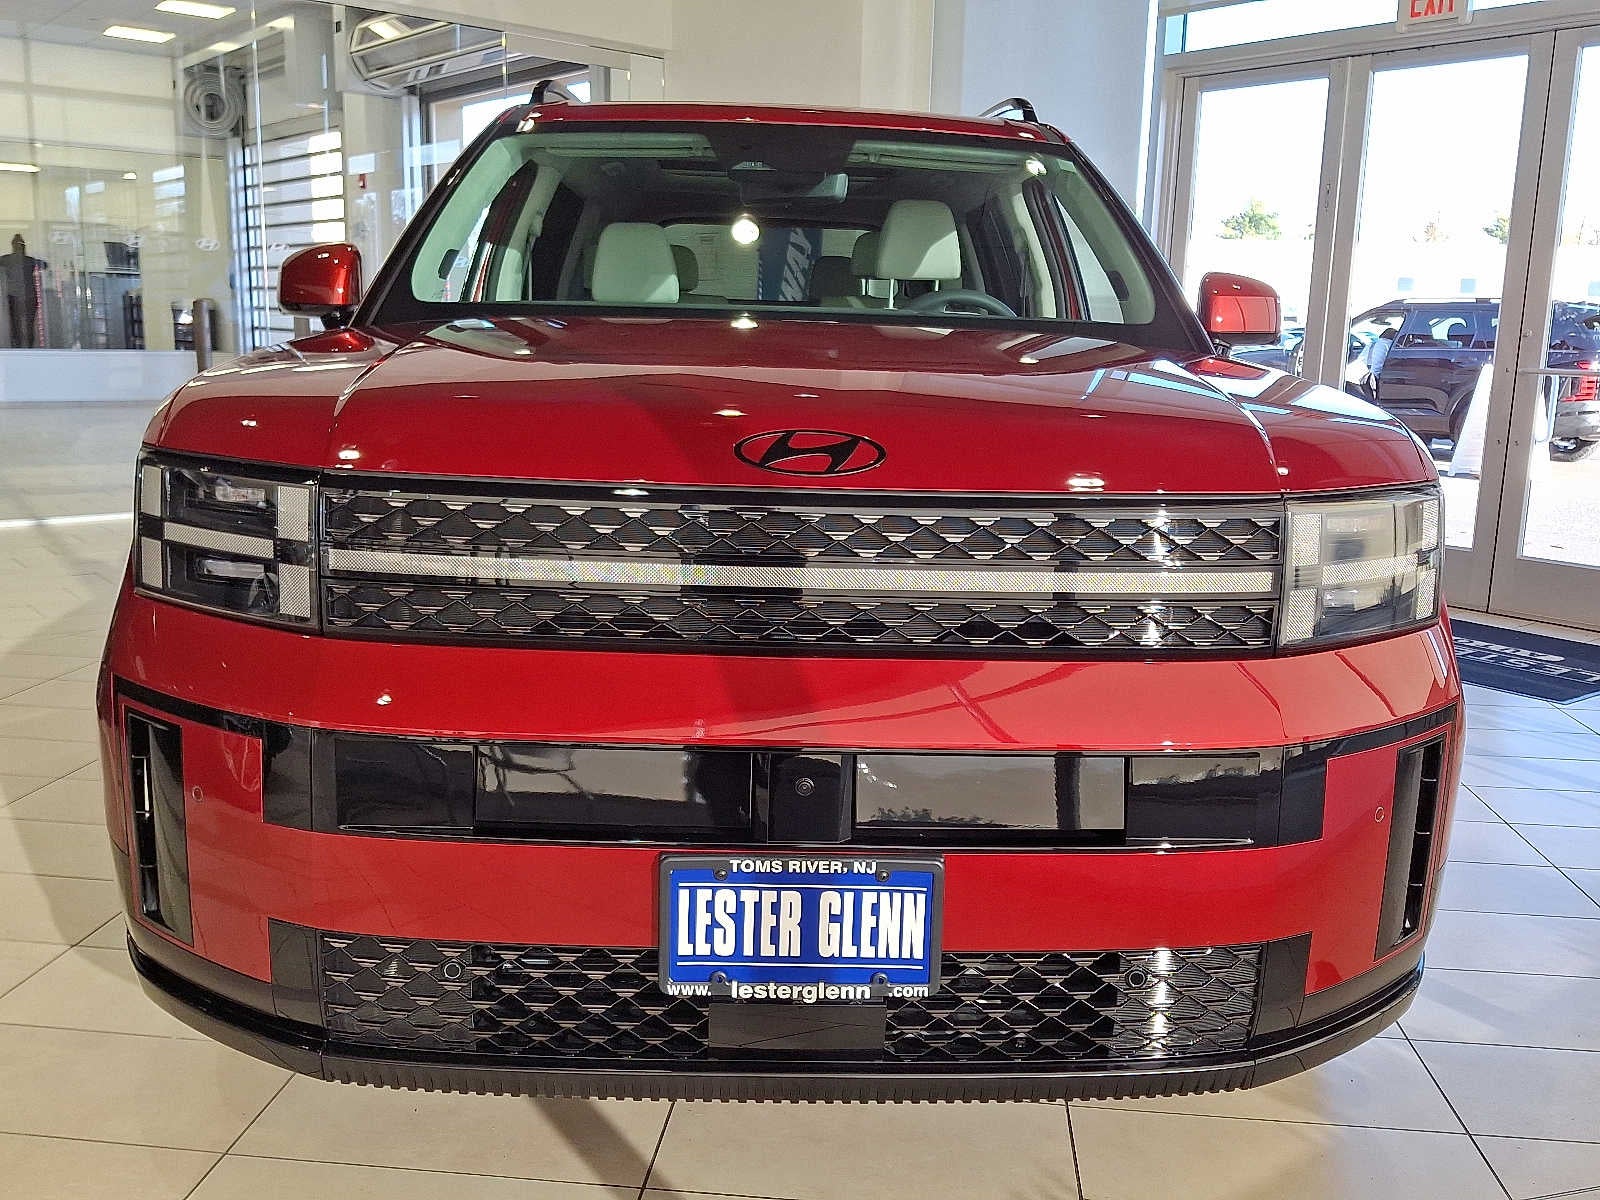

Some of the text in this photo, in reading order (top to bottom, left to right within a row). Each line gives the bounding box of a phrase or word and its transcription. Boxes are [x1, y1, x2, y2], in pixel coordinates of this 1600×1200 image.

[729, 859, 877, 875] TOMS RIVER, NJ
[677, 888, 926, 959] LESTER GLENN
[666, 980, 929, 1003] www. lesterglenn .com
